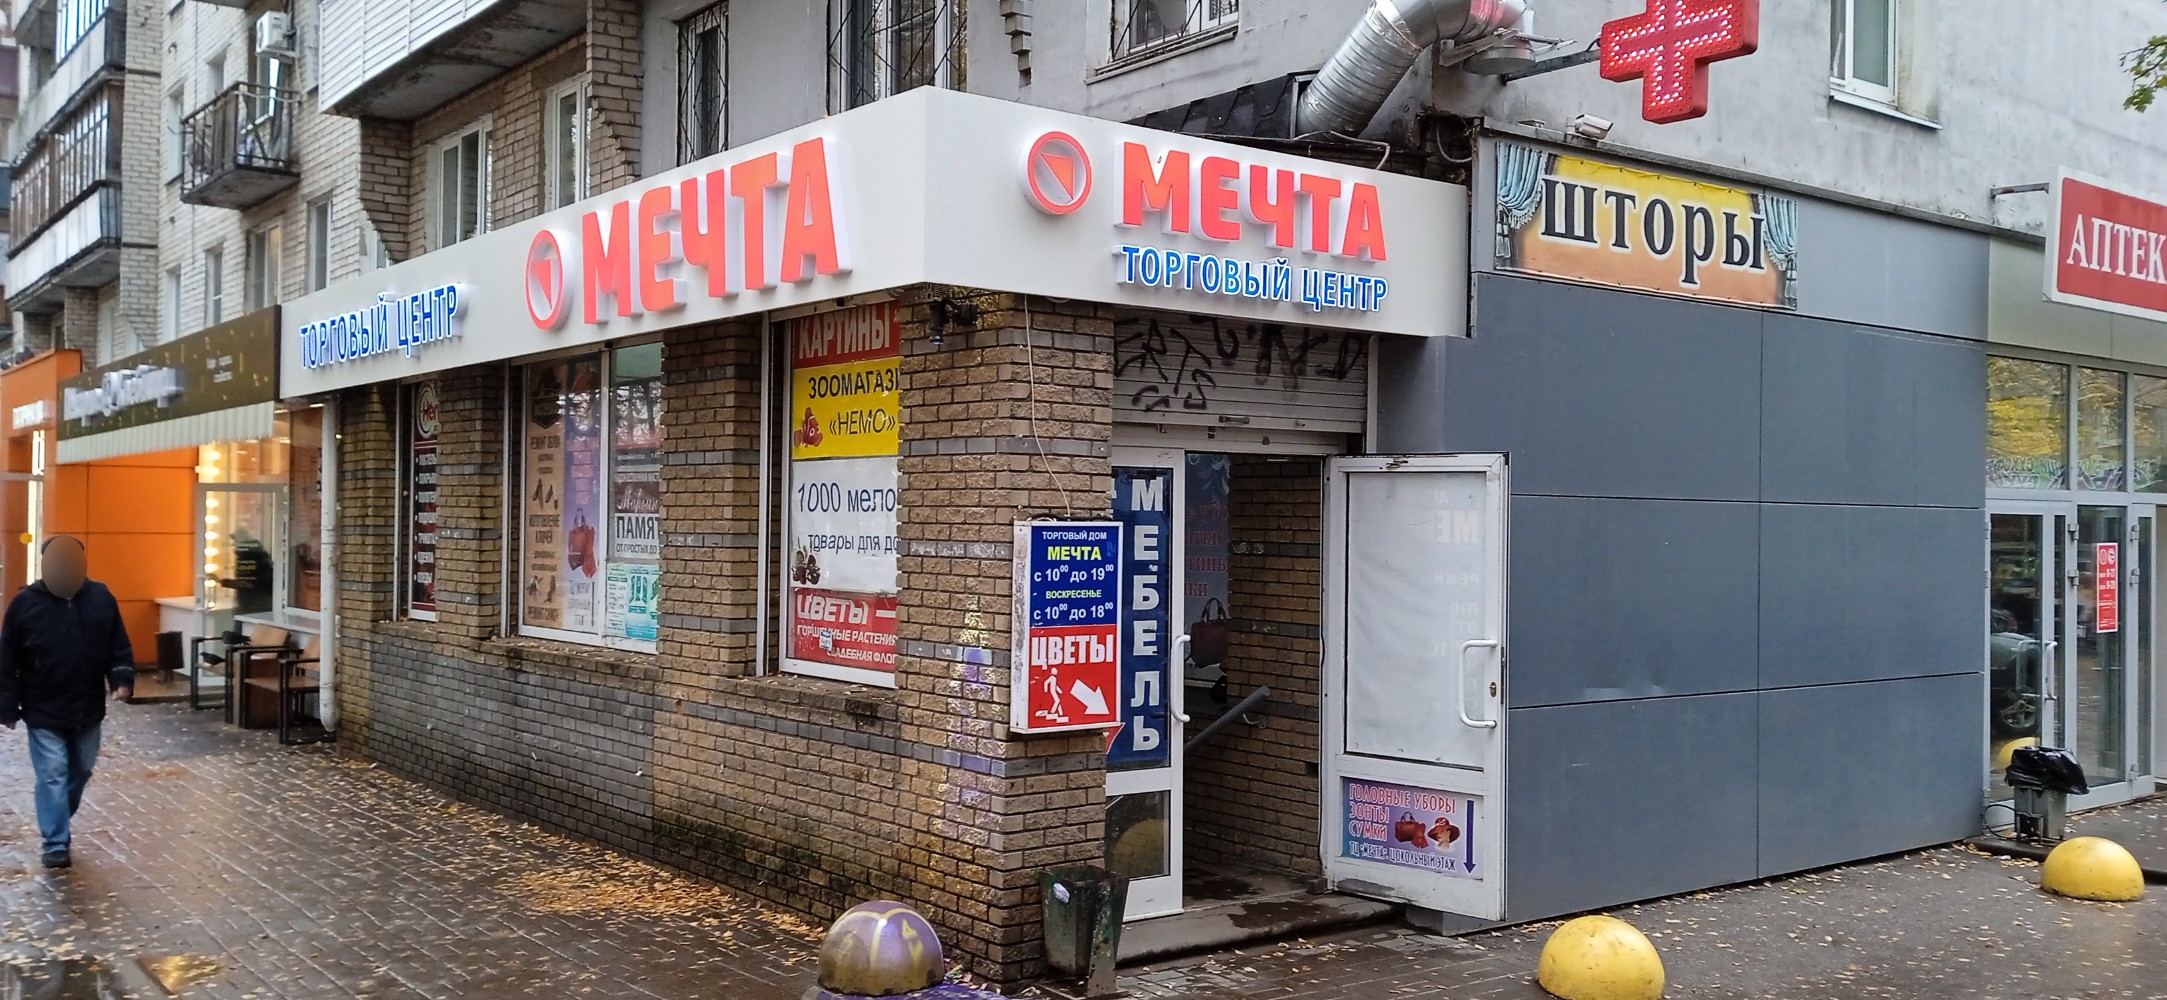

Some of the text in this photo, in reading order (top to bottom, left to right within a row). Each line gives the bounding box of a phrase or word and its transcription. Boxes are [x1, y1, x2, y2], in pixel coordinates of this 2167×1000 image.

[1119, 141, 1387, 262] МЕЧТА
[582, 136, 843, 325] МЕЧТА
[2066, 213, 2167, 285] АПТЕК
[1119, 244, 1389, 312] ТОРГОВЫЙ ЦЕНТР
[300, 284, 459, 370] ТОРГОВЫЙ ЦЕНТР
[798, 302, 891, 360] КАРТИНЫ
[829, 407, 896, 436] «НЕМО»
[797, 482, 896, 513] 1000 мело
[808, 534, 854, 554] товары
[857, 535, 881, 554] для
[1042, 530, 1107, 541] ТОРГОВЫЙ ДОМ
[1047, 545, 1102, 560] МЕЧТА
[1034, 571, 1042, 582] с
[1069, 571, 1088, 583] до
[797, 594, 869, 625] ЦВЕТЫ
[1045, 589, 1102, 599] ВОСКРЕСЕНЬЕ
[1033, 609, 1042, 620] с
[1069, 608, 1087, 621] до
[1130, 476, 1163, 752] МЕБЕЛЬ
[1031, 633, 1114, 670] ЦВЕТЫ
[1349, 783, 1456, 814] ГОЛОВНЫЕ УБОРЫ
[1349, 802, 1390, 824] ЗОНТЫ
[1349, 821, 1388, 842] СУМКИ
[1389, 847, 1435, 869] ЦОКОЛЬНЫЙ
[1435, 856, 1456, 872] ЭТАЖ
